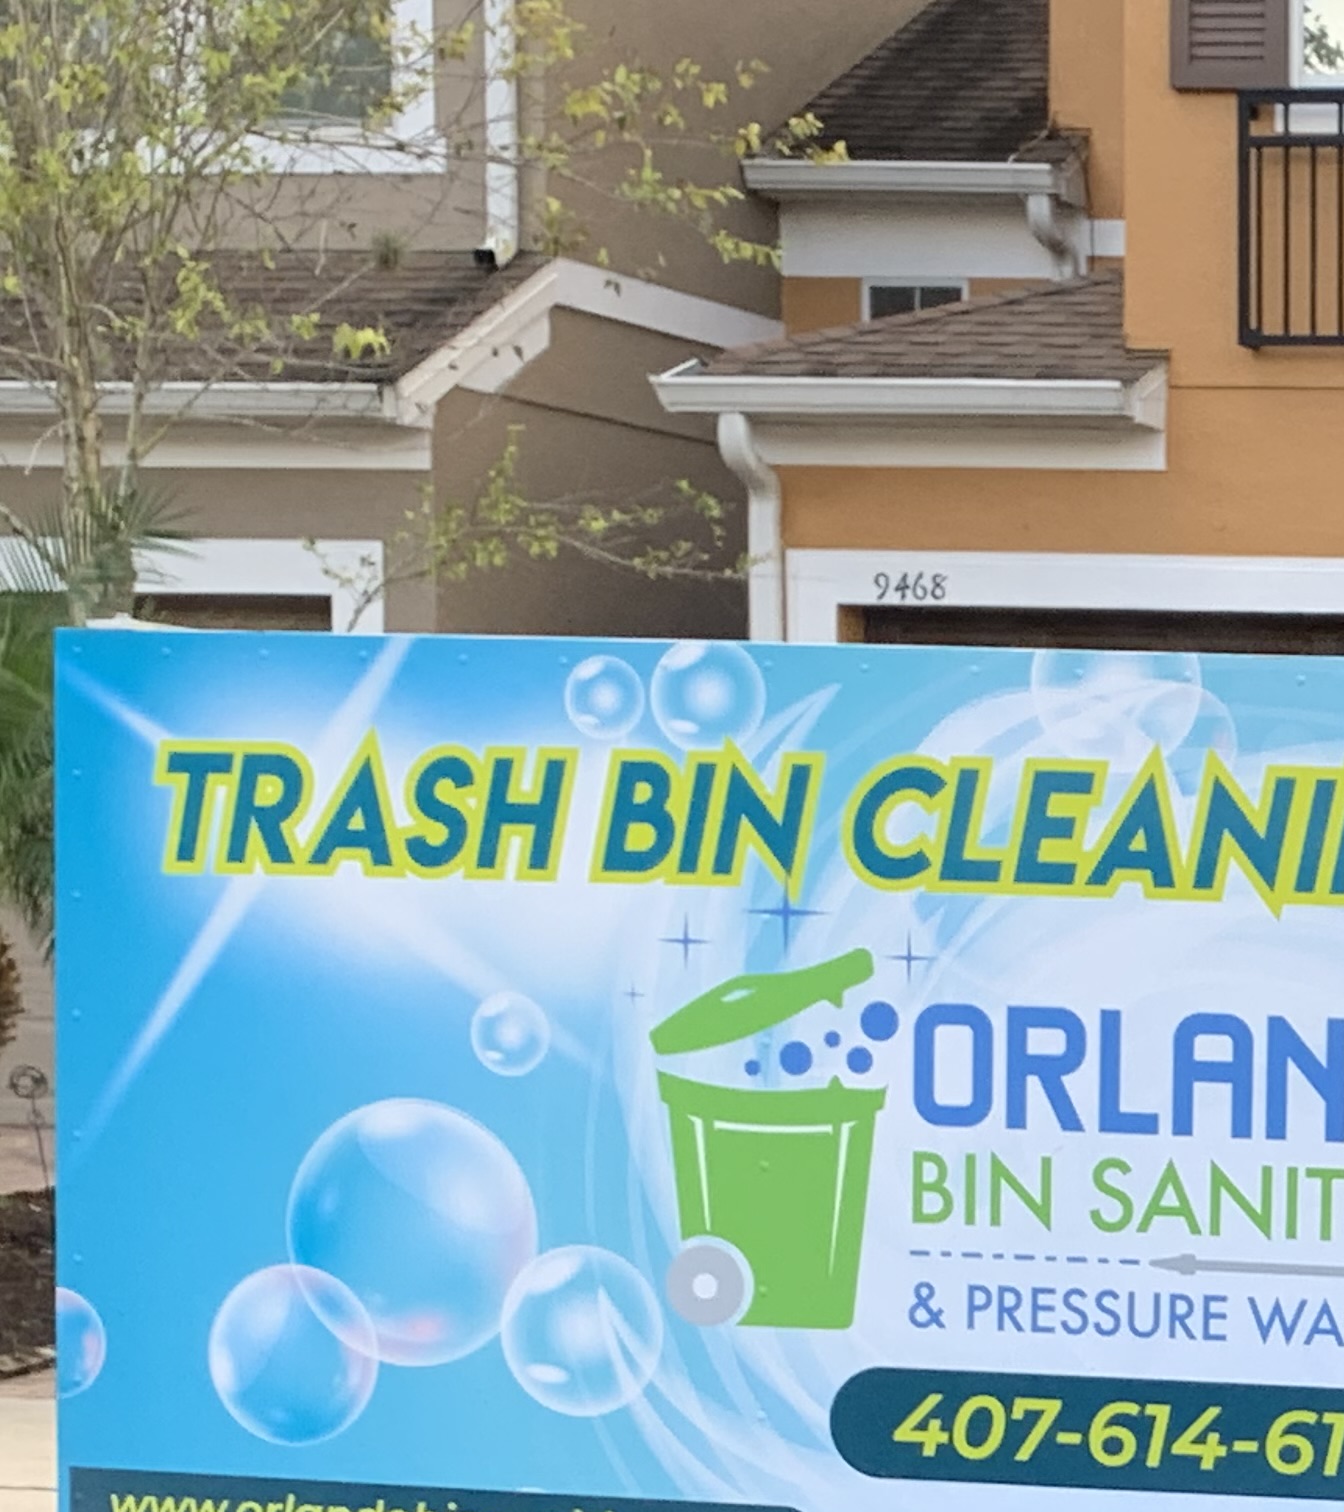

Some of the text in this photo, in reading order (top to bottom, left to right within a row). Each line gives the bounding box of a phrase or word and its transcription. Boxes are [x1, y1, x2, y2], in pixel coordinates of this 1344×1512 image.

[874, 571, 948, 600] 9468
[158, 729, 577, 882] TRASH
[590, 740, 823, 902] BIN
[911, 1150, 1053, 1231] BIN
[908, 1281, 946, 1329] &
[965, 1285, 1229, 1343] PRESSURE
